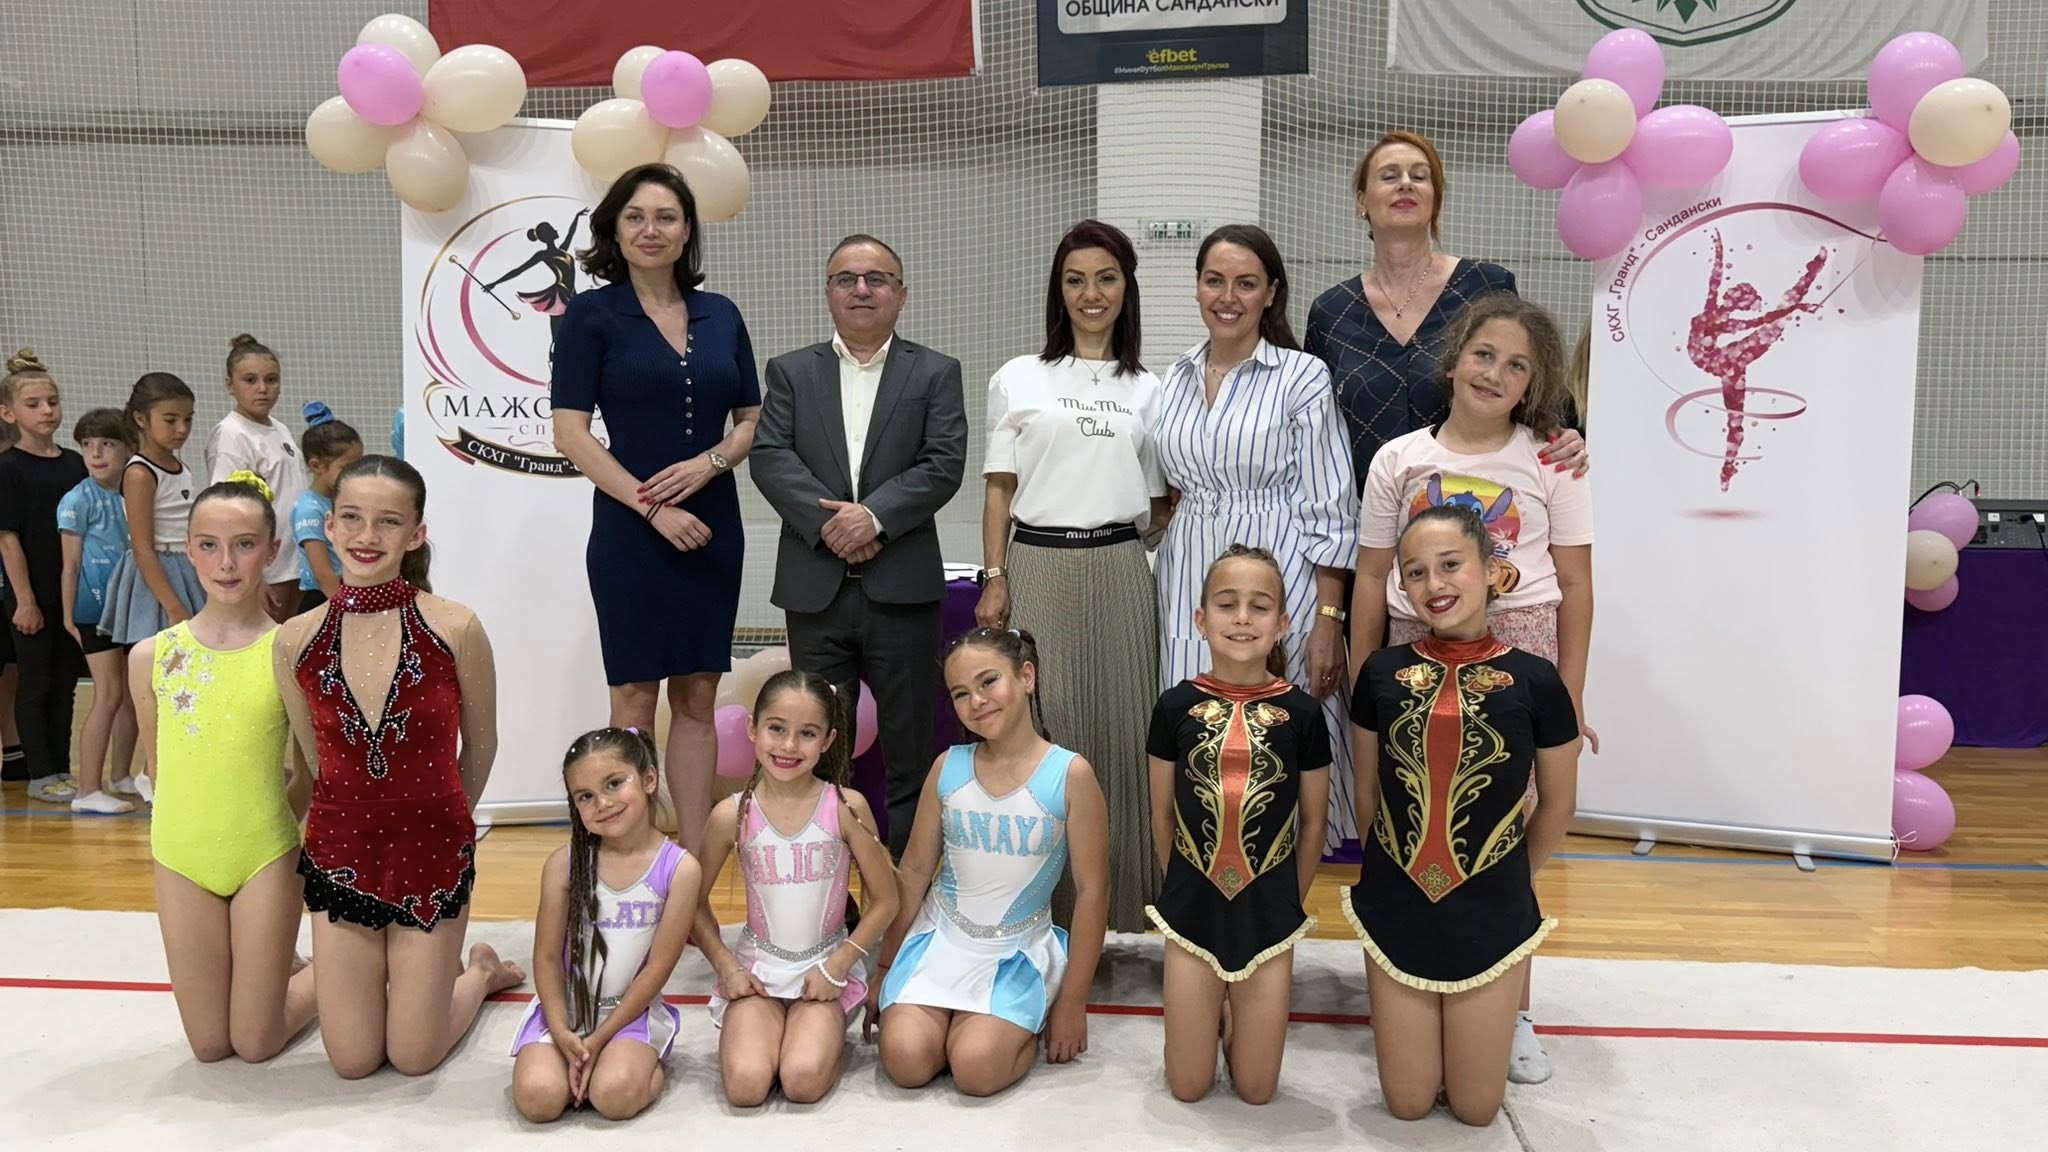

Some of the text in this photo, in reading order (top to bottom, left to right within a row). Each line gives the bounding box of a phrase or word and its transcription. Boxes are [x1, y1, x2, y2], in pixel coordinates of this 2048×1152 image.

[1065, 0, 1150, 17] ОБЩИНА
[1147, 48, 1197, 63] efbet
[1607, 304, 1625, 342] СКХГ
[1645, 197, 1722, 241] Сандански
[443, 395, 602, 420] МАЖО
[1058, 397, 1133, 415] Miu Miu
[1076, 416, 1115, 438] Club
[467, 440, 511, 464] СКХГ
